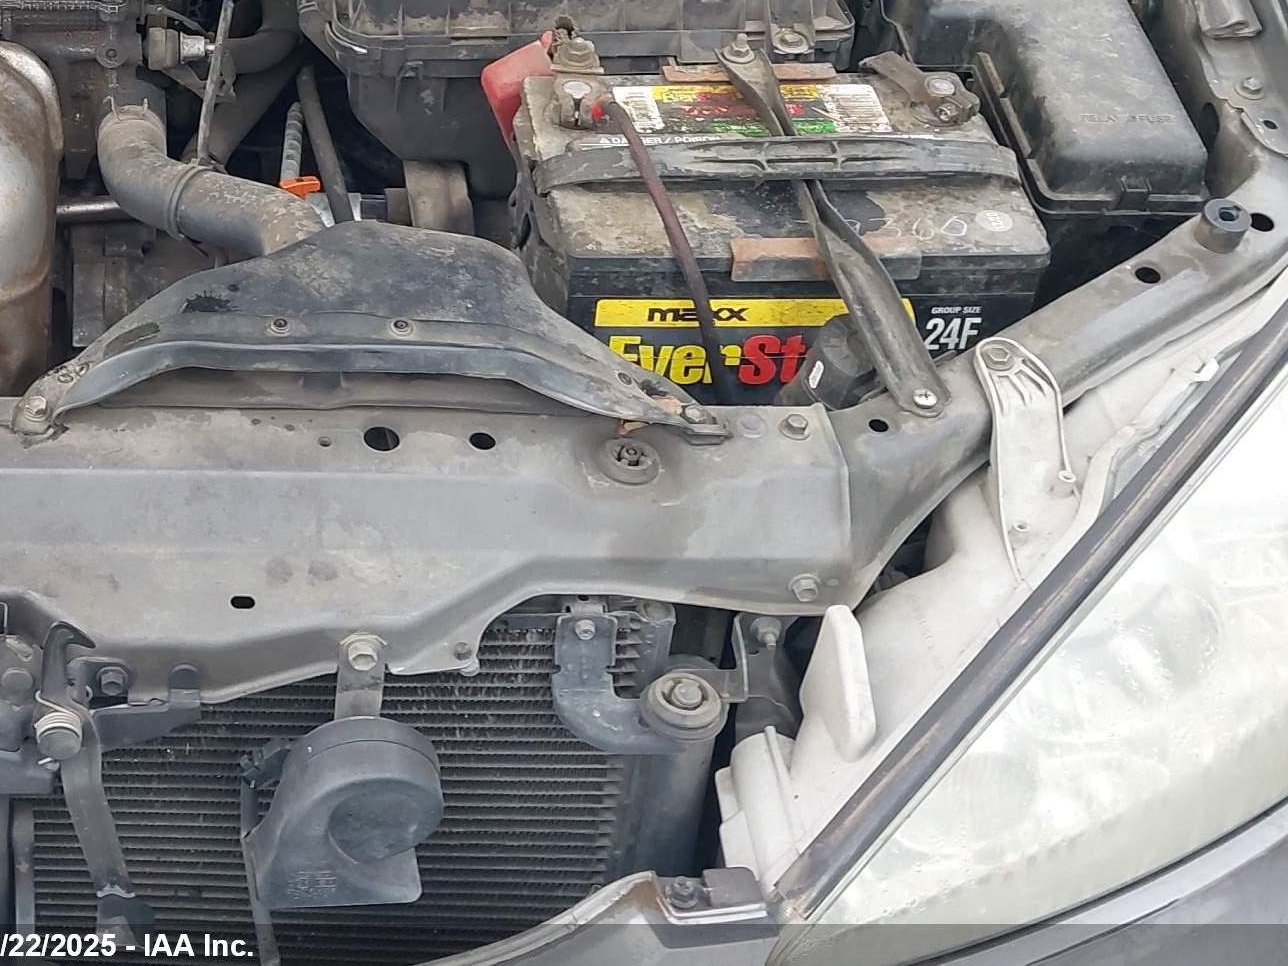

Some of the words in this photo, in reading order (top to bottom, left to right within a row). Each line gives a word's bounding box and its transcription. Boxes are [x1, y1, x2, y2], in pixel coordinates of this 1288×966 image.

[931, 306, 961, 315] GROUP
[962, 306, 983, 314] SIZE
[924, 317, 983, 351] 24F
[609, 334, 806, 385] EverSt
